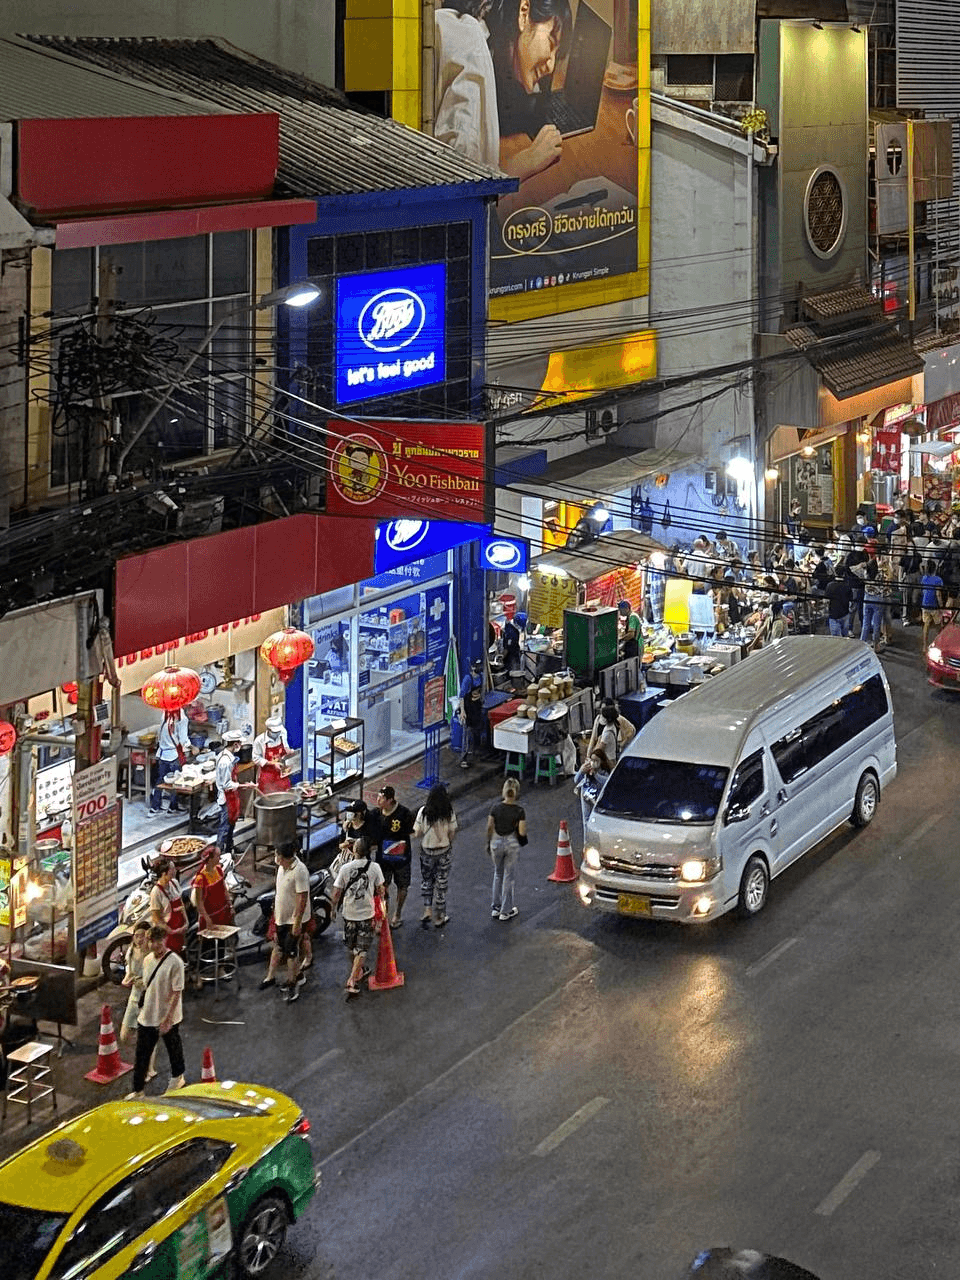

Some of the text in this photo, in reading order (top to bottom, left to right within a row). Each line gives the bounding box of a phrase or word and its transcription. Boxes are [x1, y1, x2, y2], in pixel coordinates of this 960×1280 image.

[507, 205, 634, 245] กรุงศรี ชีวิตง่ายได้ทุกวัน
[403, 352, 435, 377] good
[77, 795, 107, 820] 700
